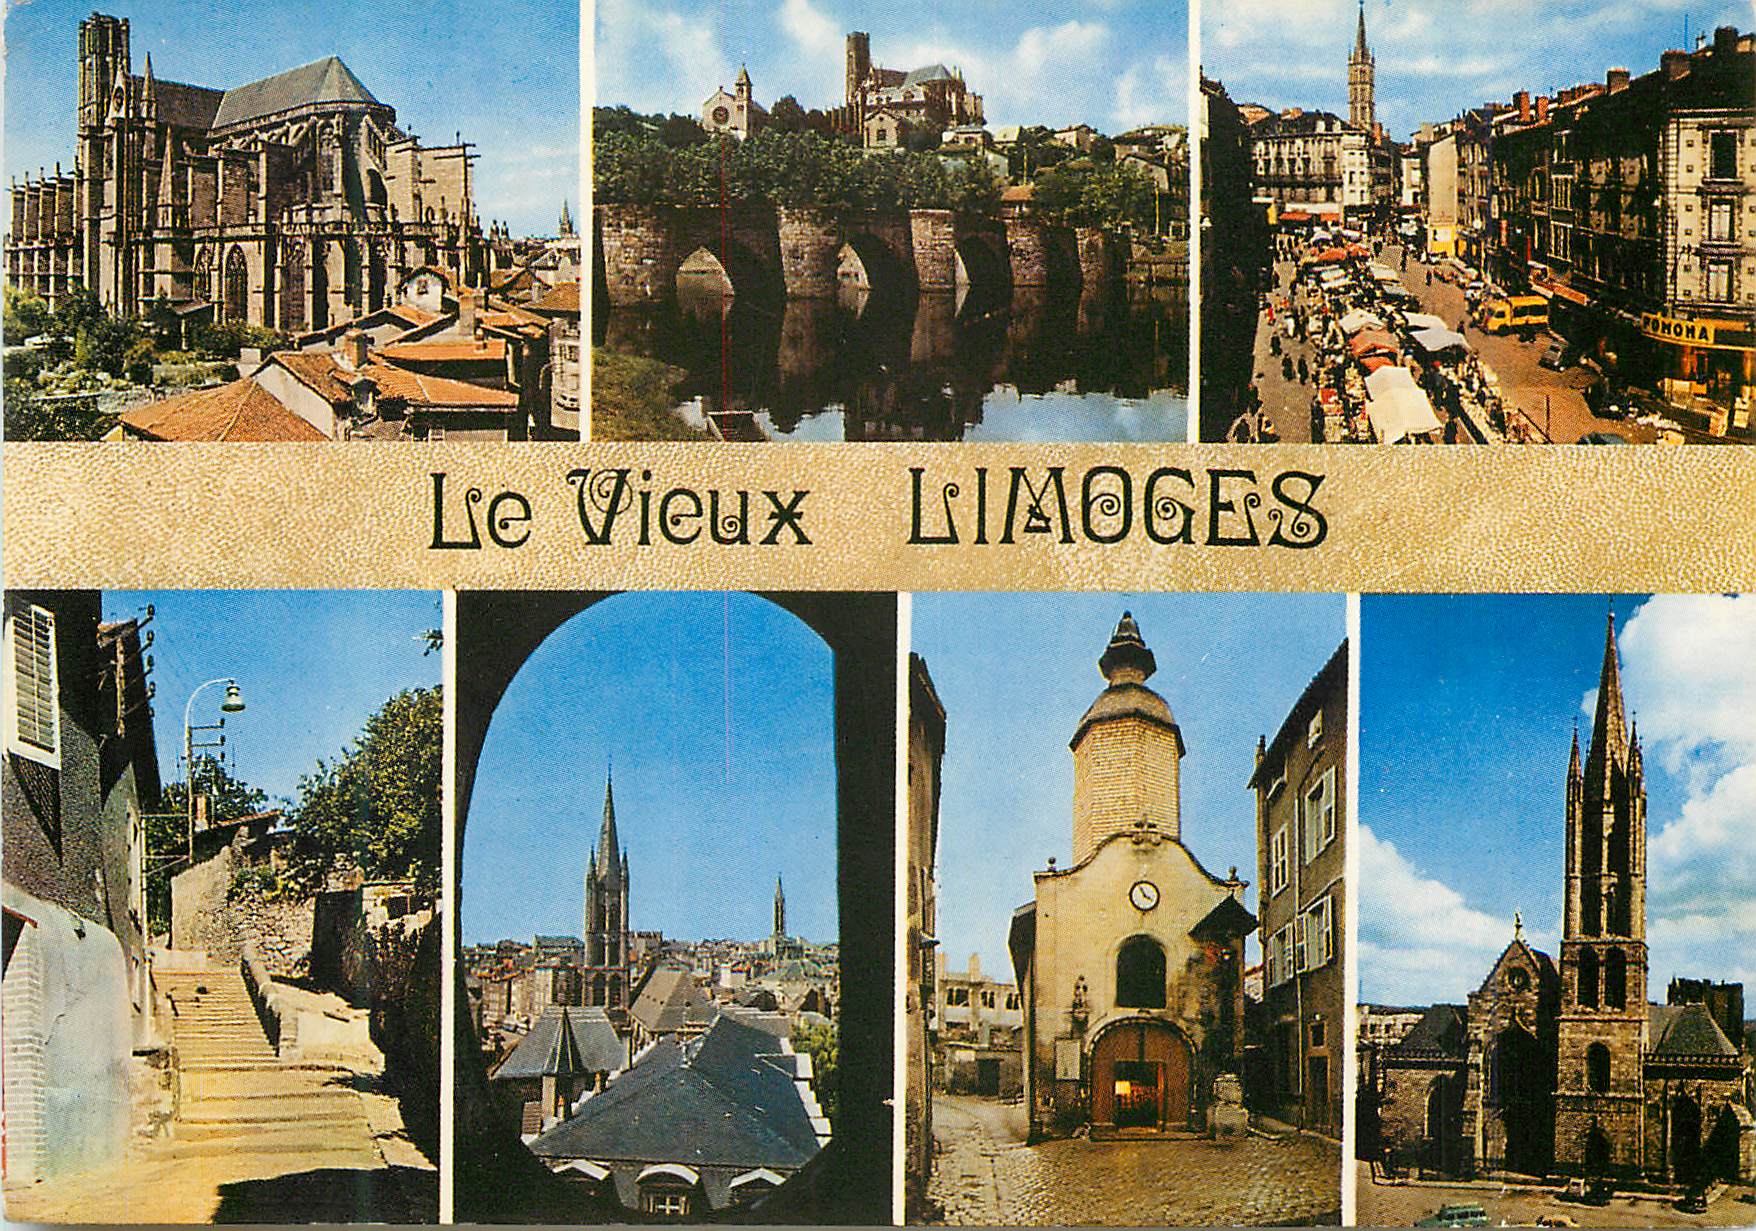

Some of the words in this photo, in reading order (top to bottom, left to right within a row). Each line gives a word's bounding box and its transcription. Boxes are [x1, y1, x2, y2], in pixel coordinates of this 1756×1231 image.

[1643, 316, 1709, 341] POMONA
[429, 473, 532, 550] Le
[566, 468, 813, 550] Vieux
[907, 465, 1329, 550] LIMOGES
